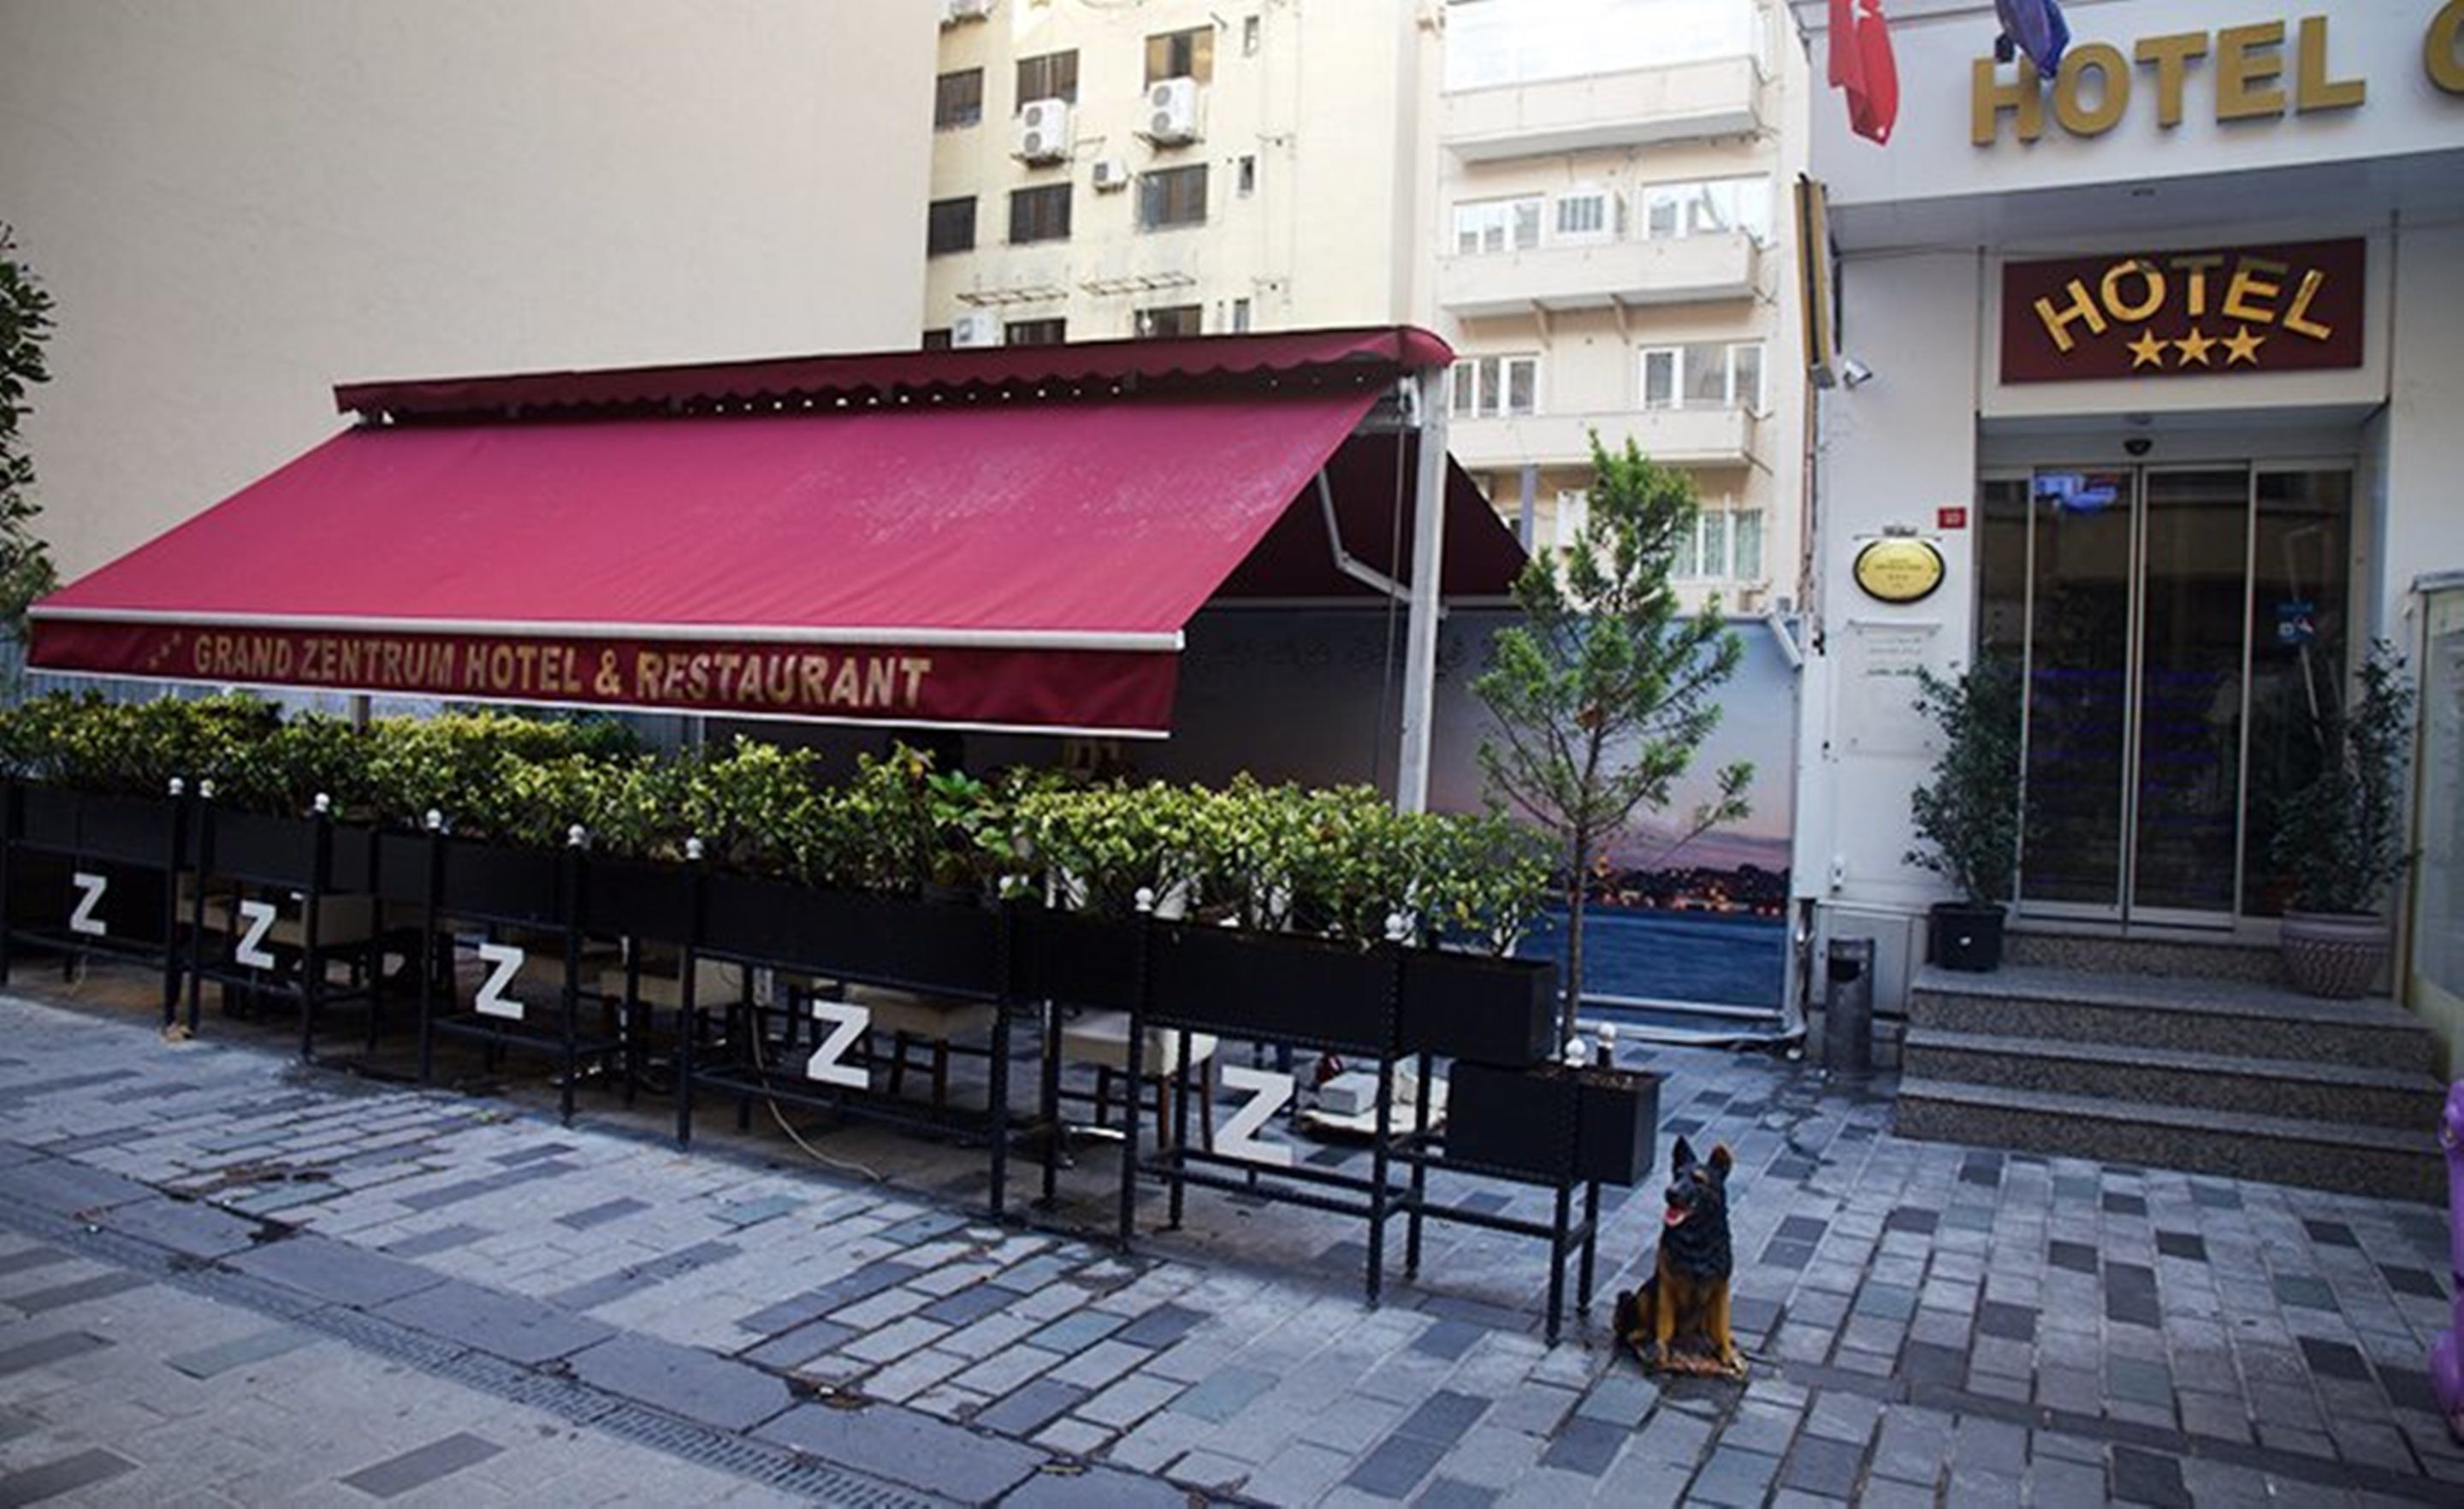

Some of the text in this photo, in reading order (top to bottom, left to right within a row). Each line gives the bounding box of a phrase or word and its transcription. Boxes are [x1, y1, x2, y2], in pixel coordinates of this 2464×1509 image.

[1972, 15, 2366, 146] HOTEL
[2034, 256, 2332, 352] HOTEL
[193, 635, 933, 707] GRAND ZENTRUM HOTEL & RESTAURANT
[69, 872, 108, 936] Z
[234, 900, 278, 970] Z
[475, 942, 525, 1021] Z
[806, 998, 871, 1090] Z
[1212, 1063, 1296, 1168] Z
